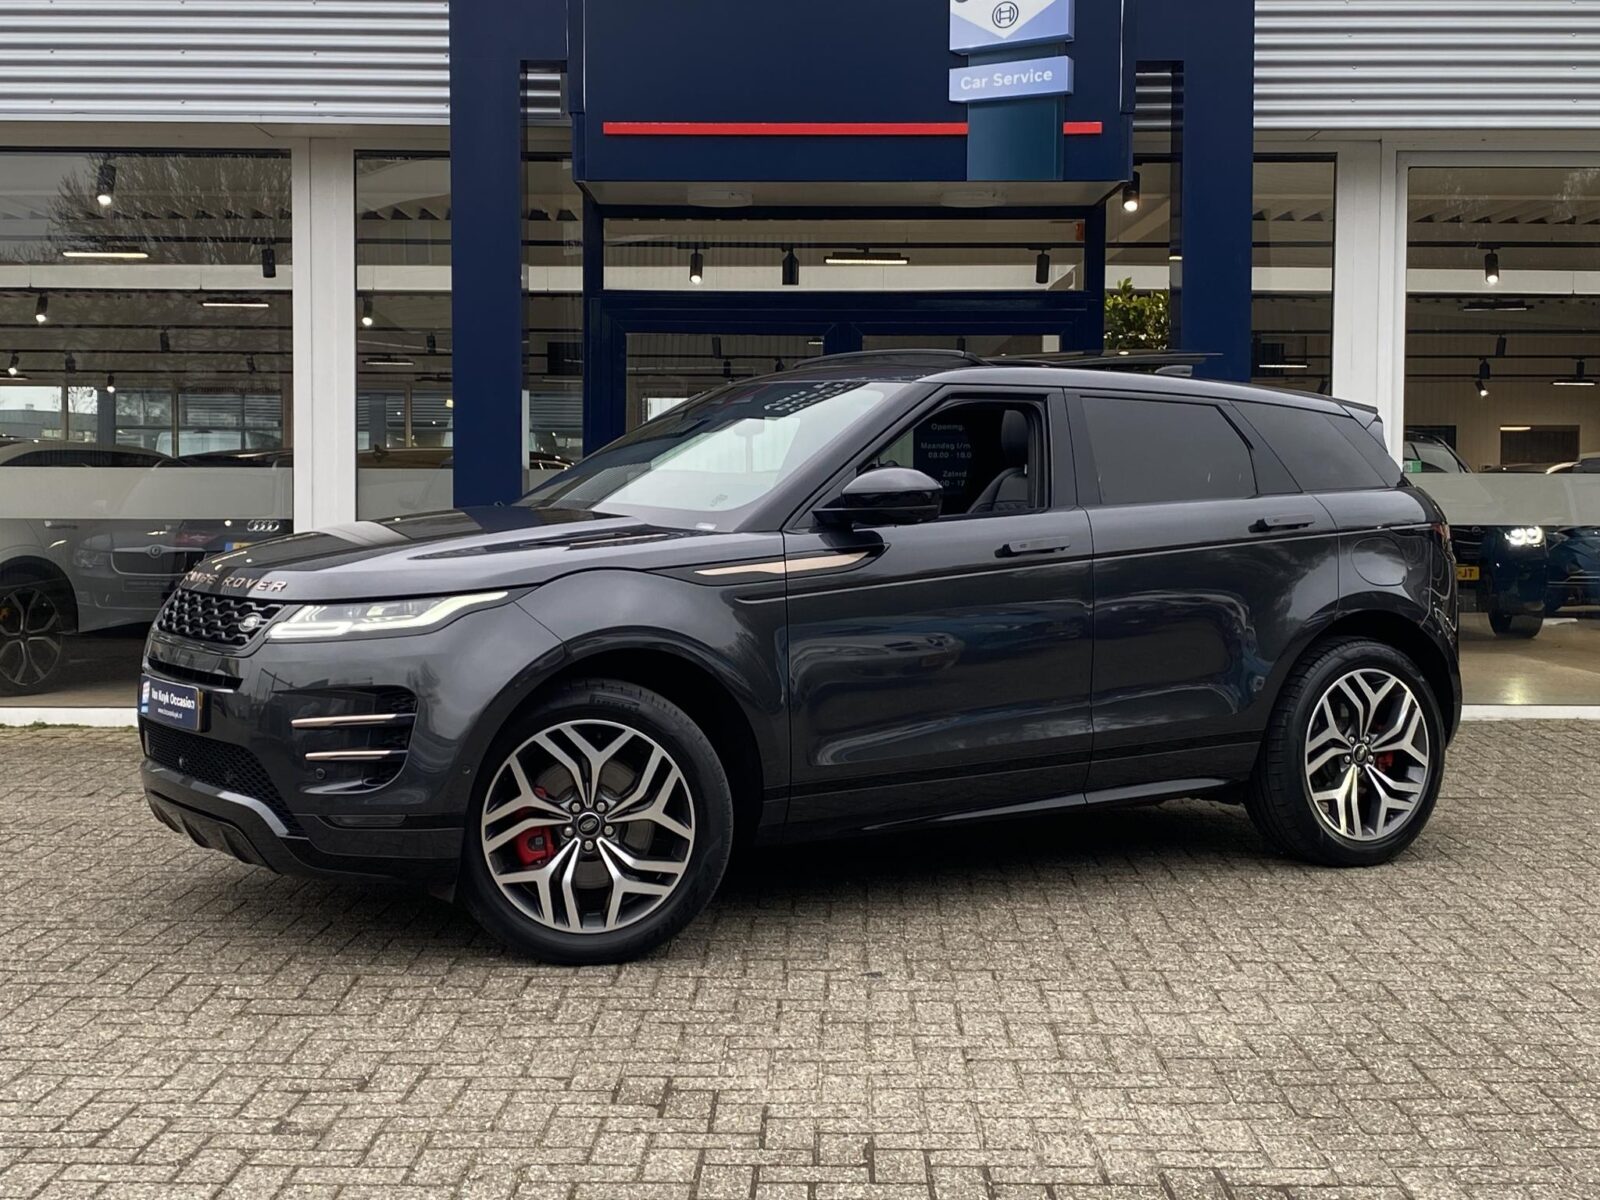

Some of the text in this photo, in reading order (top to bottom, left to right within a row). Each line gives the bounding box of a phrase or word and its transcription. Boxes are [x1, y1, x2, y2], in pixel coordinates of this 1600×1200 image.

[960, 69, 1053, 90] Car Service
[221, 576, 288, 592] ROVER
